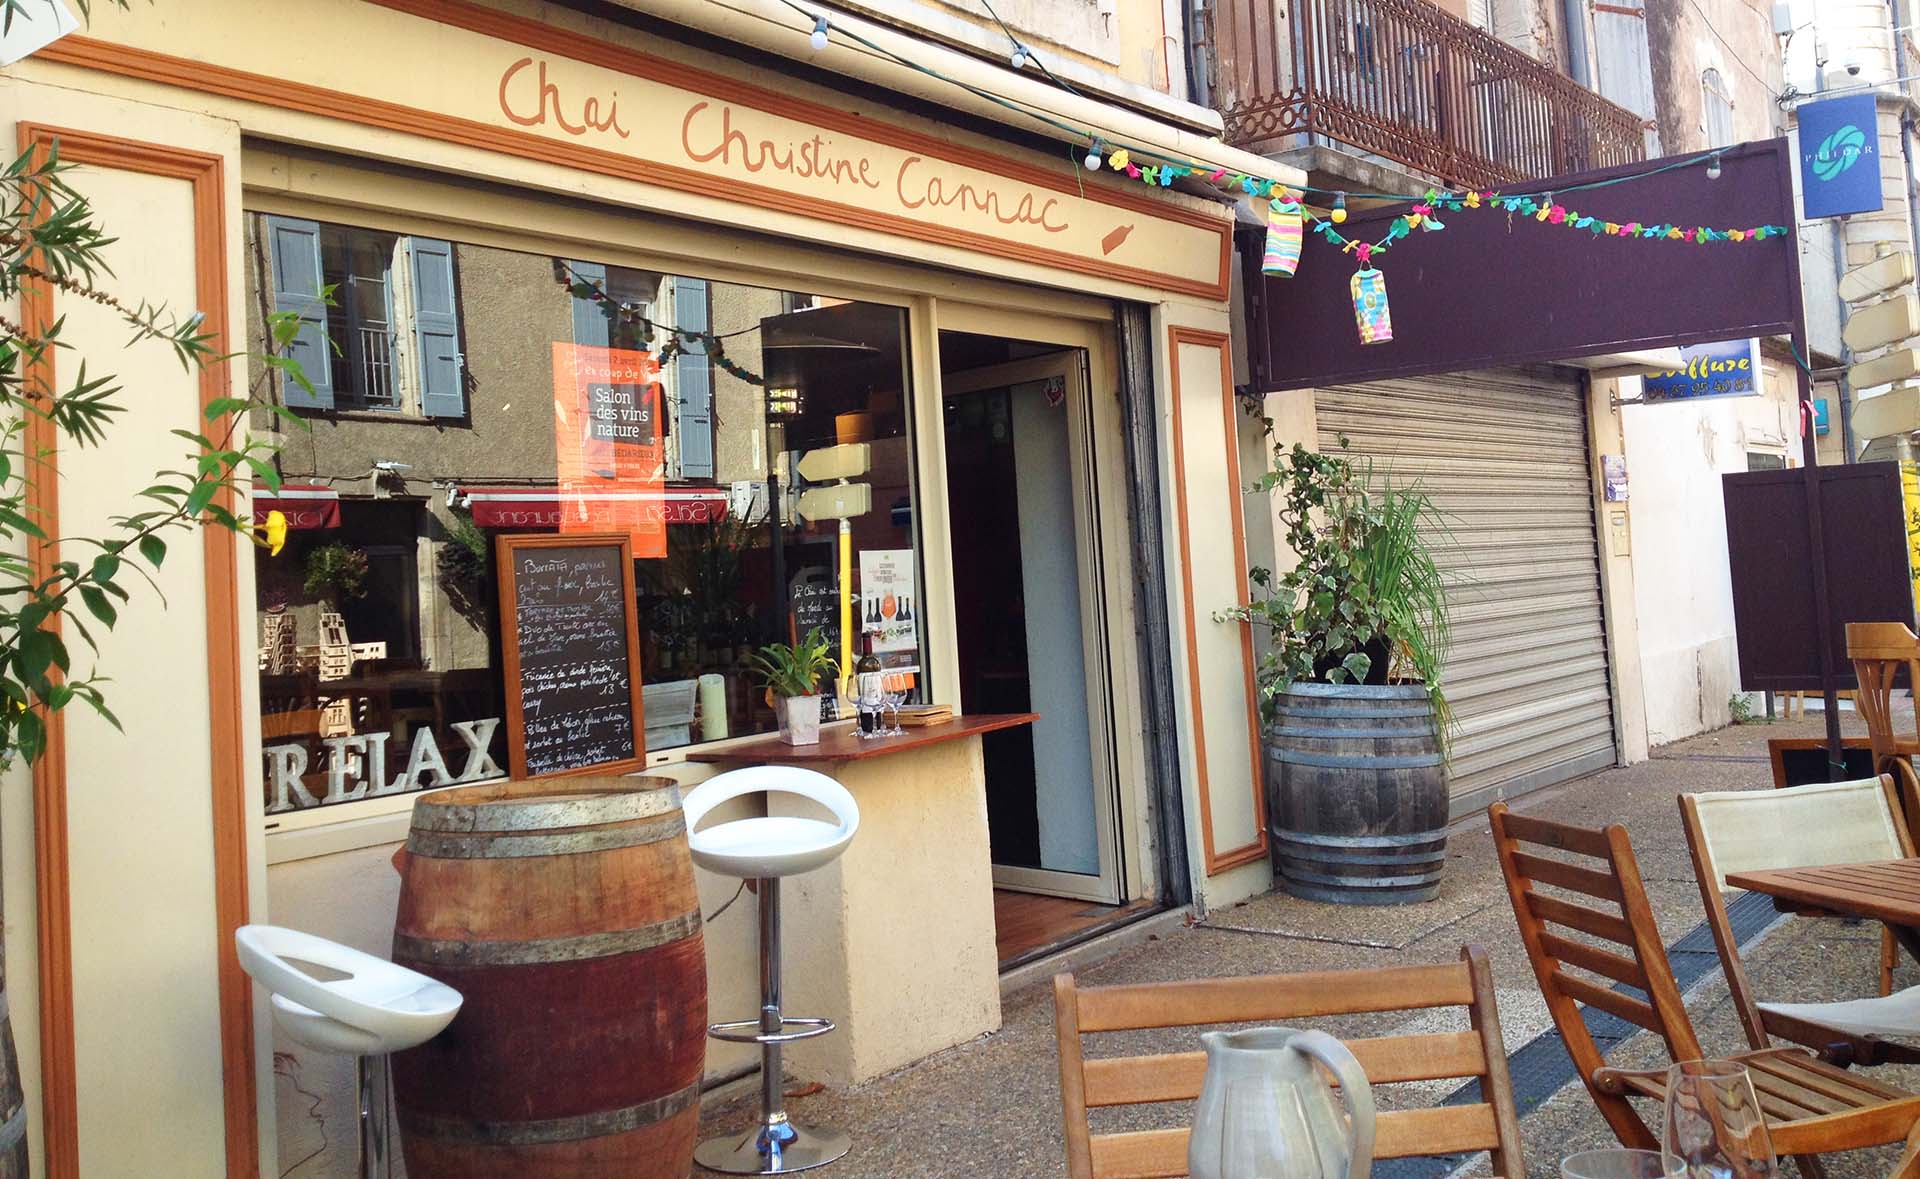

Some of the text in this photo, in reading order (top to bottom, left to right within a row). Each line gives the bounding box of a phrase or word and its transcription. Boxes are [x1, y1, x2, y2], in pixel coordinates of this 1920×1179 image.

[499, 57, 1068, 234] Chai Christine Cannac
[596, 387, 631, 405] Salon
[596, 405, 649, 422] des vins
[597, 423, 640, 438] nature
[263, 717, 507, 813] RELAX
